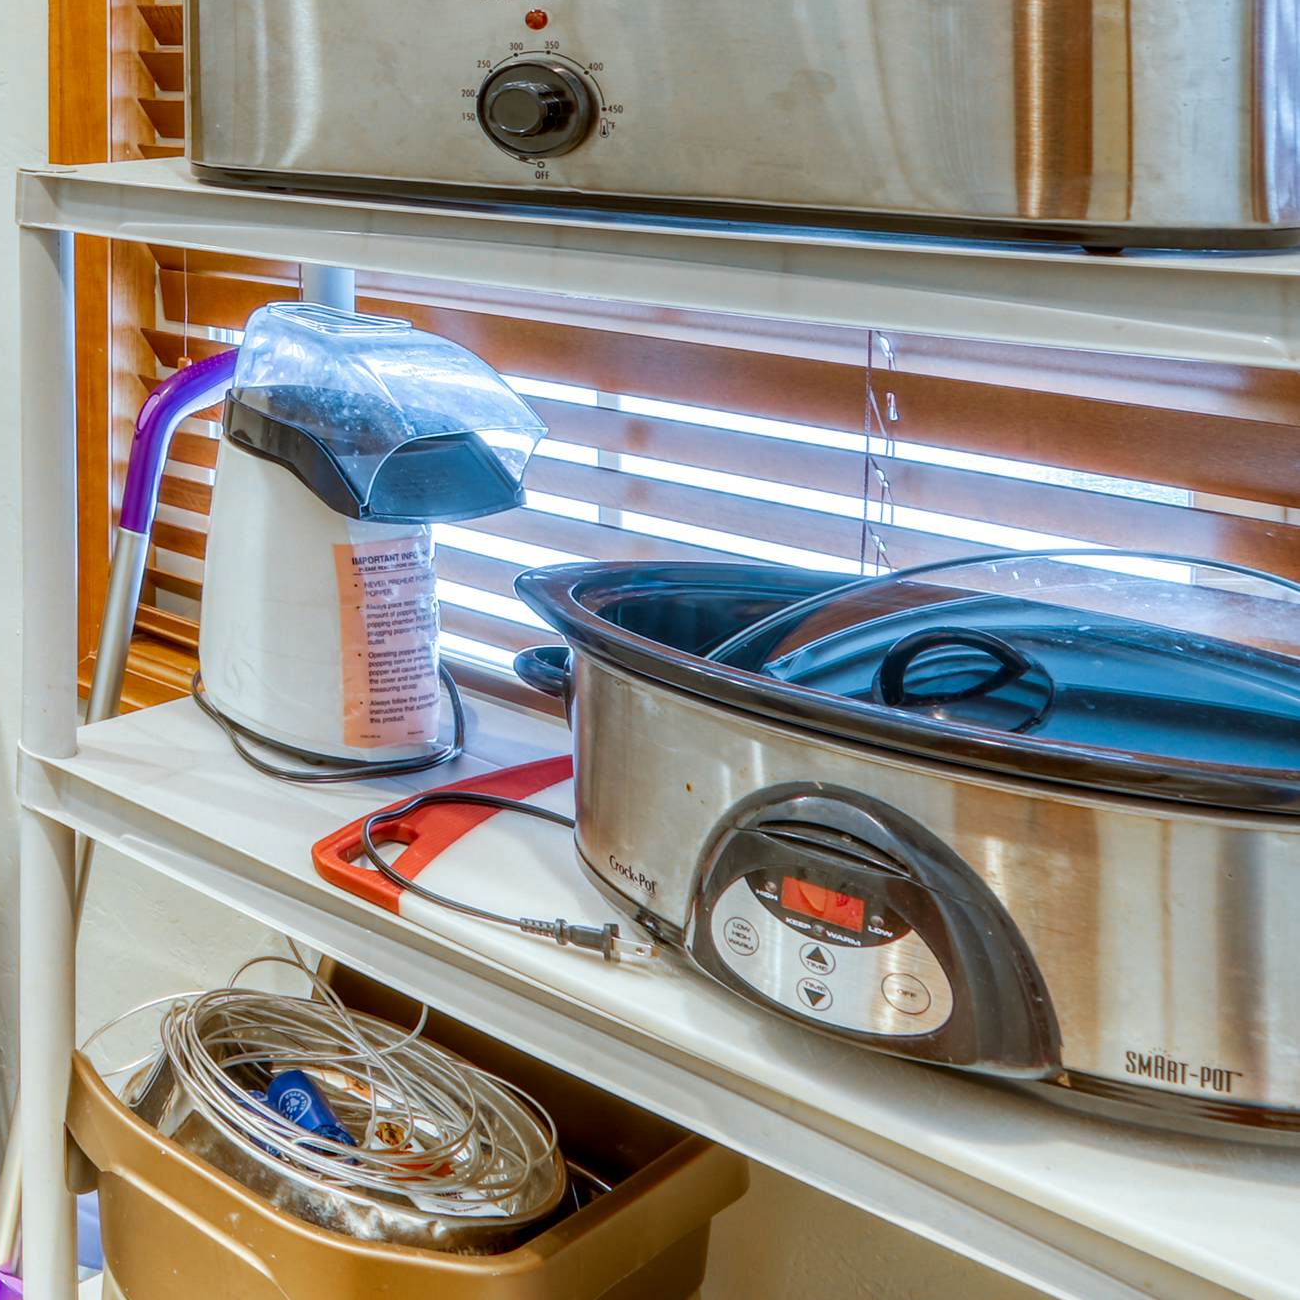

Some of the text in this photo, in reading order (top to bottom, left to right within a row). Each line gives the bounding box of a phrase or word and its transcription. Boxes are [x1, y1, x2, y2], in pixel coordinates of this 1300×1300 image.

[509, 42, 524, 51] 300
[544, 41, 560, 50] 350
[477, 60, 491, 69] 250
[588, 62, 604, 72] 400
[461, 89, 476, 98] 200
[608, 105, 624, 114] 450
[462, 112, 476, 121] 150
[535, 171, 550, 180] OFF
[351, 553, 400, 566] IMPORTANT
[732, 922, 751, 932] LOW
[867, 925, 894, 938] LOW
[732, 930, 751, 941] HIGH
[826, 930, 862, 947] WARM
[729, 938, 754, 952] WARM
[806, 961, 829, 973] TIME
[804, 980, 827, 993] TIME
[897, 988, 918, 999] OFF
[1125, 1050, 1243, 1093] SMART-POT
